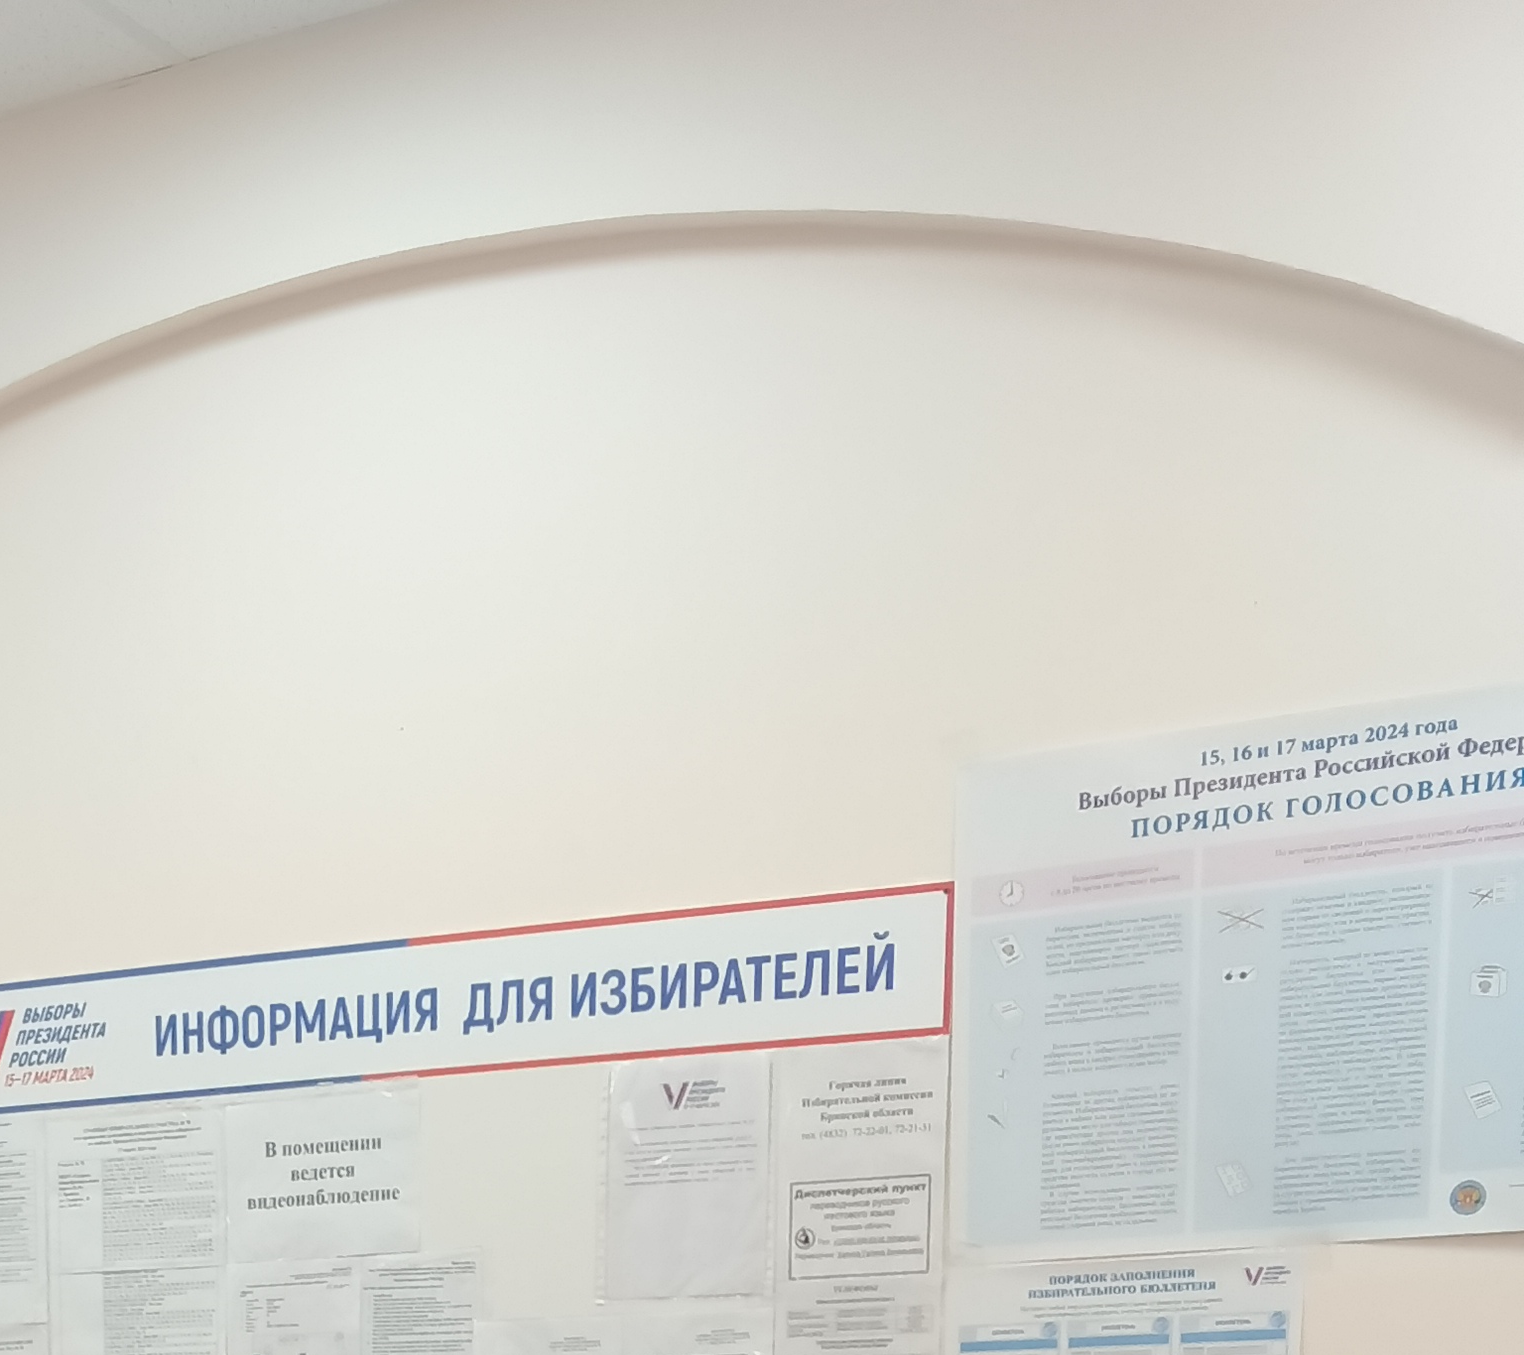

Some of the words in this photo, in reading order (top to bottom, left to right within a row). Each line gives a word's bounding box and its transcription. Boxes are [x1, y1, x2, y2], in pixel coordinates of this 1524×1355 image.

[1200, 749, 1226, 768] 15,
[1232, 745, 1254, 762] 16
[1257, 745, 1270, 759] и
[1276, 738, 1297, 756] 17
[1300, 732, 1359, 756] марта
[1364, 722, 1410, 743] 2024
[1415, 718, 1459, 738] года
[1078, 784, 1168, 811] Выборы
[1173, 766, 1308, 801] Президента
[1313, 743, 1451, 779] Российской
[1130, 801, 1275, 839] ПОРЯДОК
[1285, 766, 1524, 818] ГОЛОСОВАНИЯ
[154, 986, 439, 1058] ИНФОРМАЦИЯ
[462, 975, 554, 1036] ДЛЯ
[569, 931, 897, 1018] ИЗБИРАТЕЛЕЙ
[22, 1002, 88, 1025] ВЫБОРЫ
[15, 1021, 108, 1047] ПРЕЗИДЕНТА
[8, 1047, 68, 1069] РОССИИ
[32, 1068, 69, 1085] МАРТА
[68, 1065, 95, 1082] 2024
[264, 1141, 277, 1158] В
[281, 1137, 382, 1158] помещении
[290, 1164, 355, 1182] ведется
[247, 1186, 401, 1210] видеонаблюдение
[891, 1182, 927, 1194] пункт
[1048, 1272, 1108, 1287] ПОРЯДОК
[1109, 1269, 1196, 1284] ЗАПОЛНЕНИЯ
[1028, 1285, 1137, 1299] ИЗБИРАТЕЛЬНОГО
[1140, 1281, 1217, 1295] БЮЛЛЕТЕНЯ
